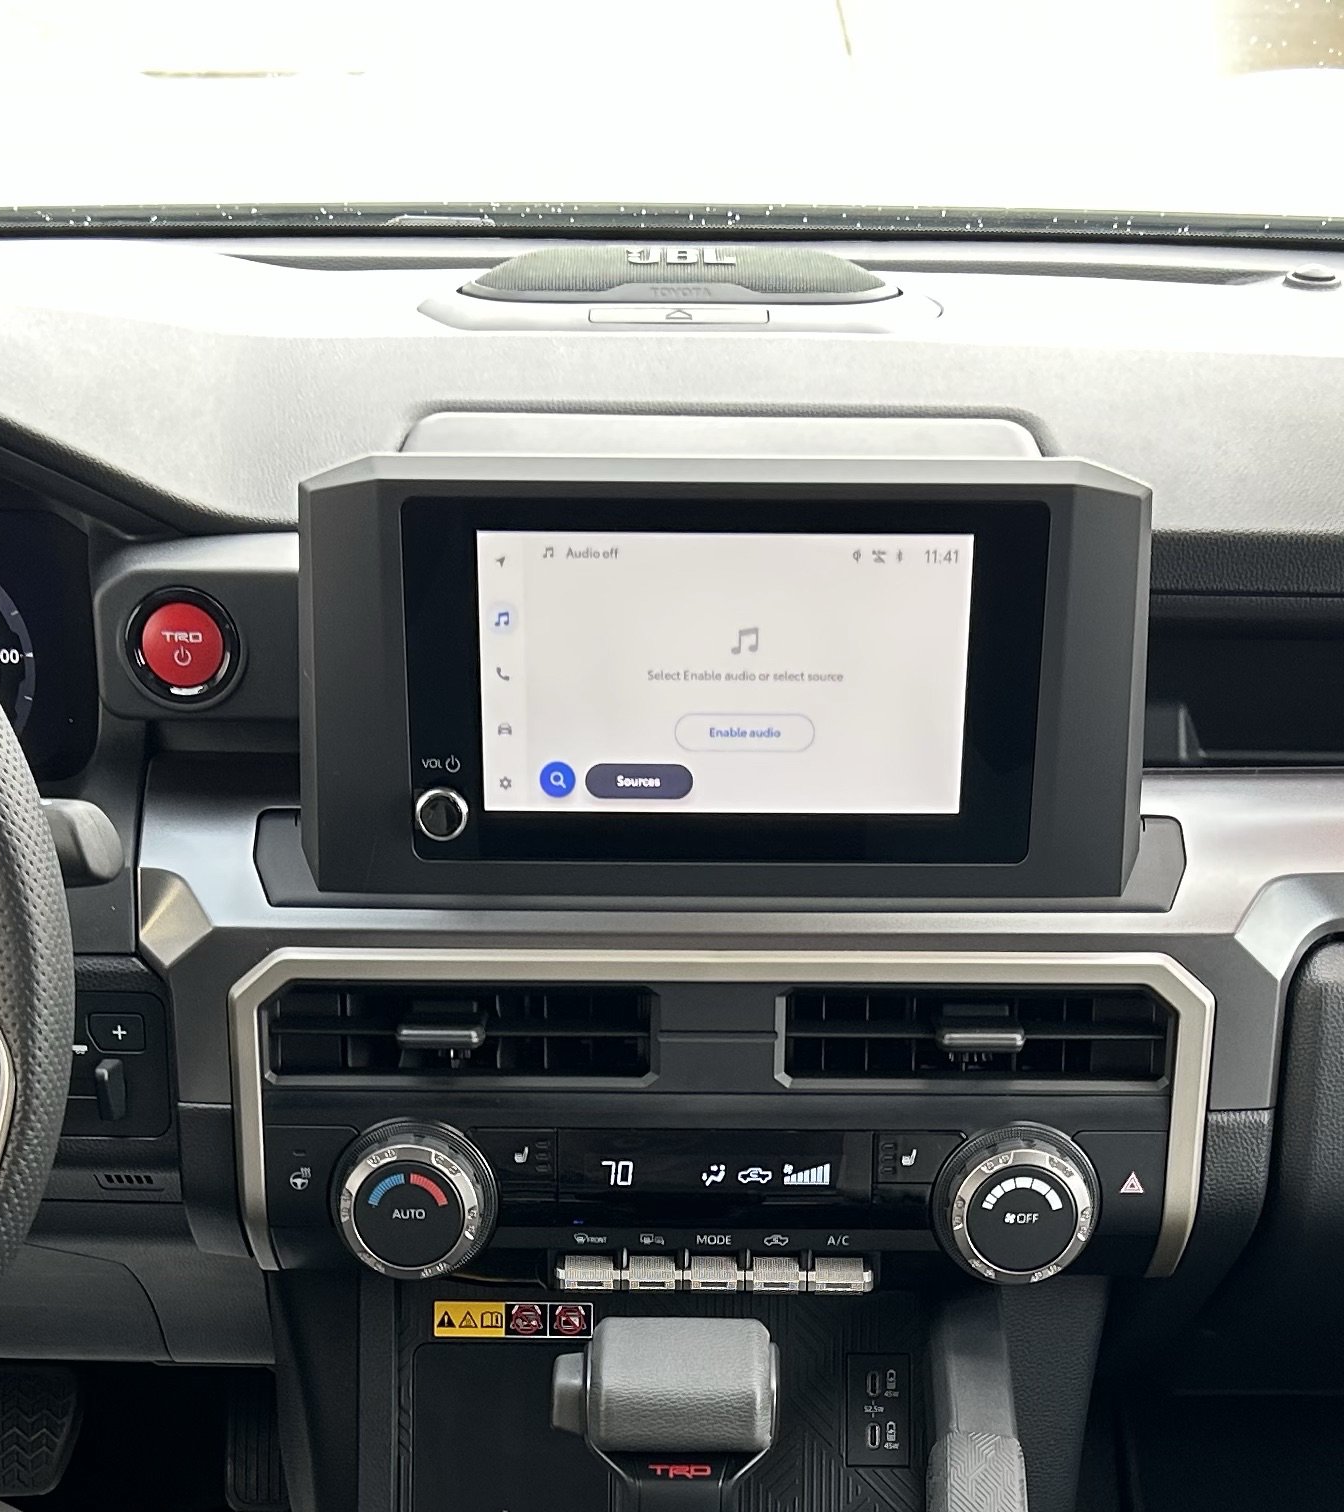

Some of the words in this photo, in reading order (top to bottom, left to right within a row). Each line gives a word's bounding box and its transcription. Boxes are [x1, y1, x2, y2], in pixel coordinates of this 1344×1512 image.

[626, 246, 737, 266] JBL
[650, 286, 712, 298] TOYOTA
[566, 547, 600, 559] Audio
[602, 547, 619, 559] off
[924, 549, 959, 565] 11:41
[161, 631, 203, 643] TRD
[647, 670, 681, 682] Select
[683, 670, 722, 682] Enable
[725, 670, 756, 682] audio
[758, 673, 771, 682] or
[772, 670, 805, 682] select
[807, 673, 843, 682] source
[709, 726, 747, 739] Enable
[749, 726, 781, 739] audio
[422, 758, 442, 770] VOL
[616, 775, 661, 788] Sources
[602, 1160, 633, 1186] 70
[392, 1208, 426, 1220] AUTO
[1017, 1212, 1039, 1224] OFF
[587, 1236, 607, 1244] FRONT
[696, 1234, 732, 1246] MODE
[827, 1234, 850, 1246] A/C
[649, 1464, 711, 1479] TRD
